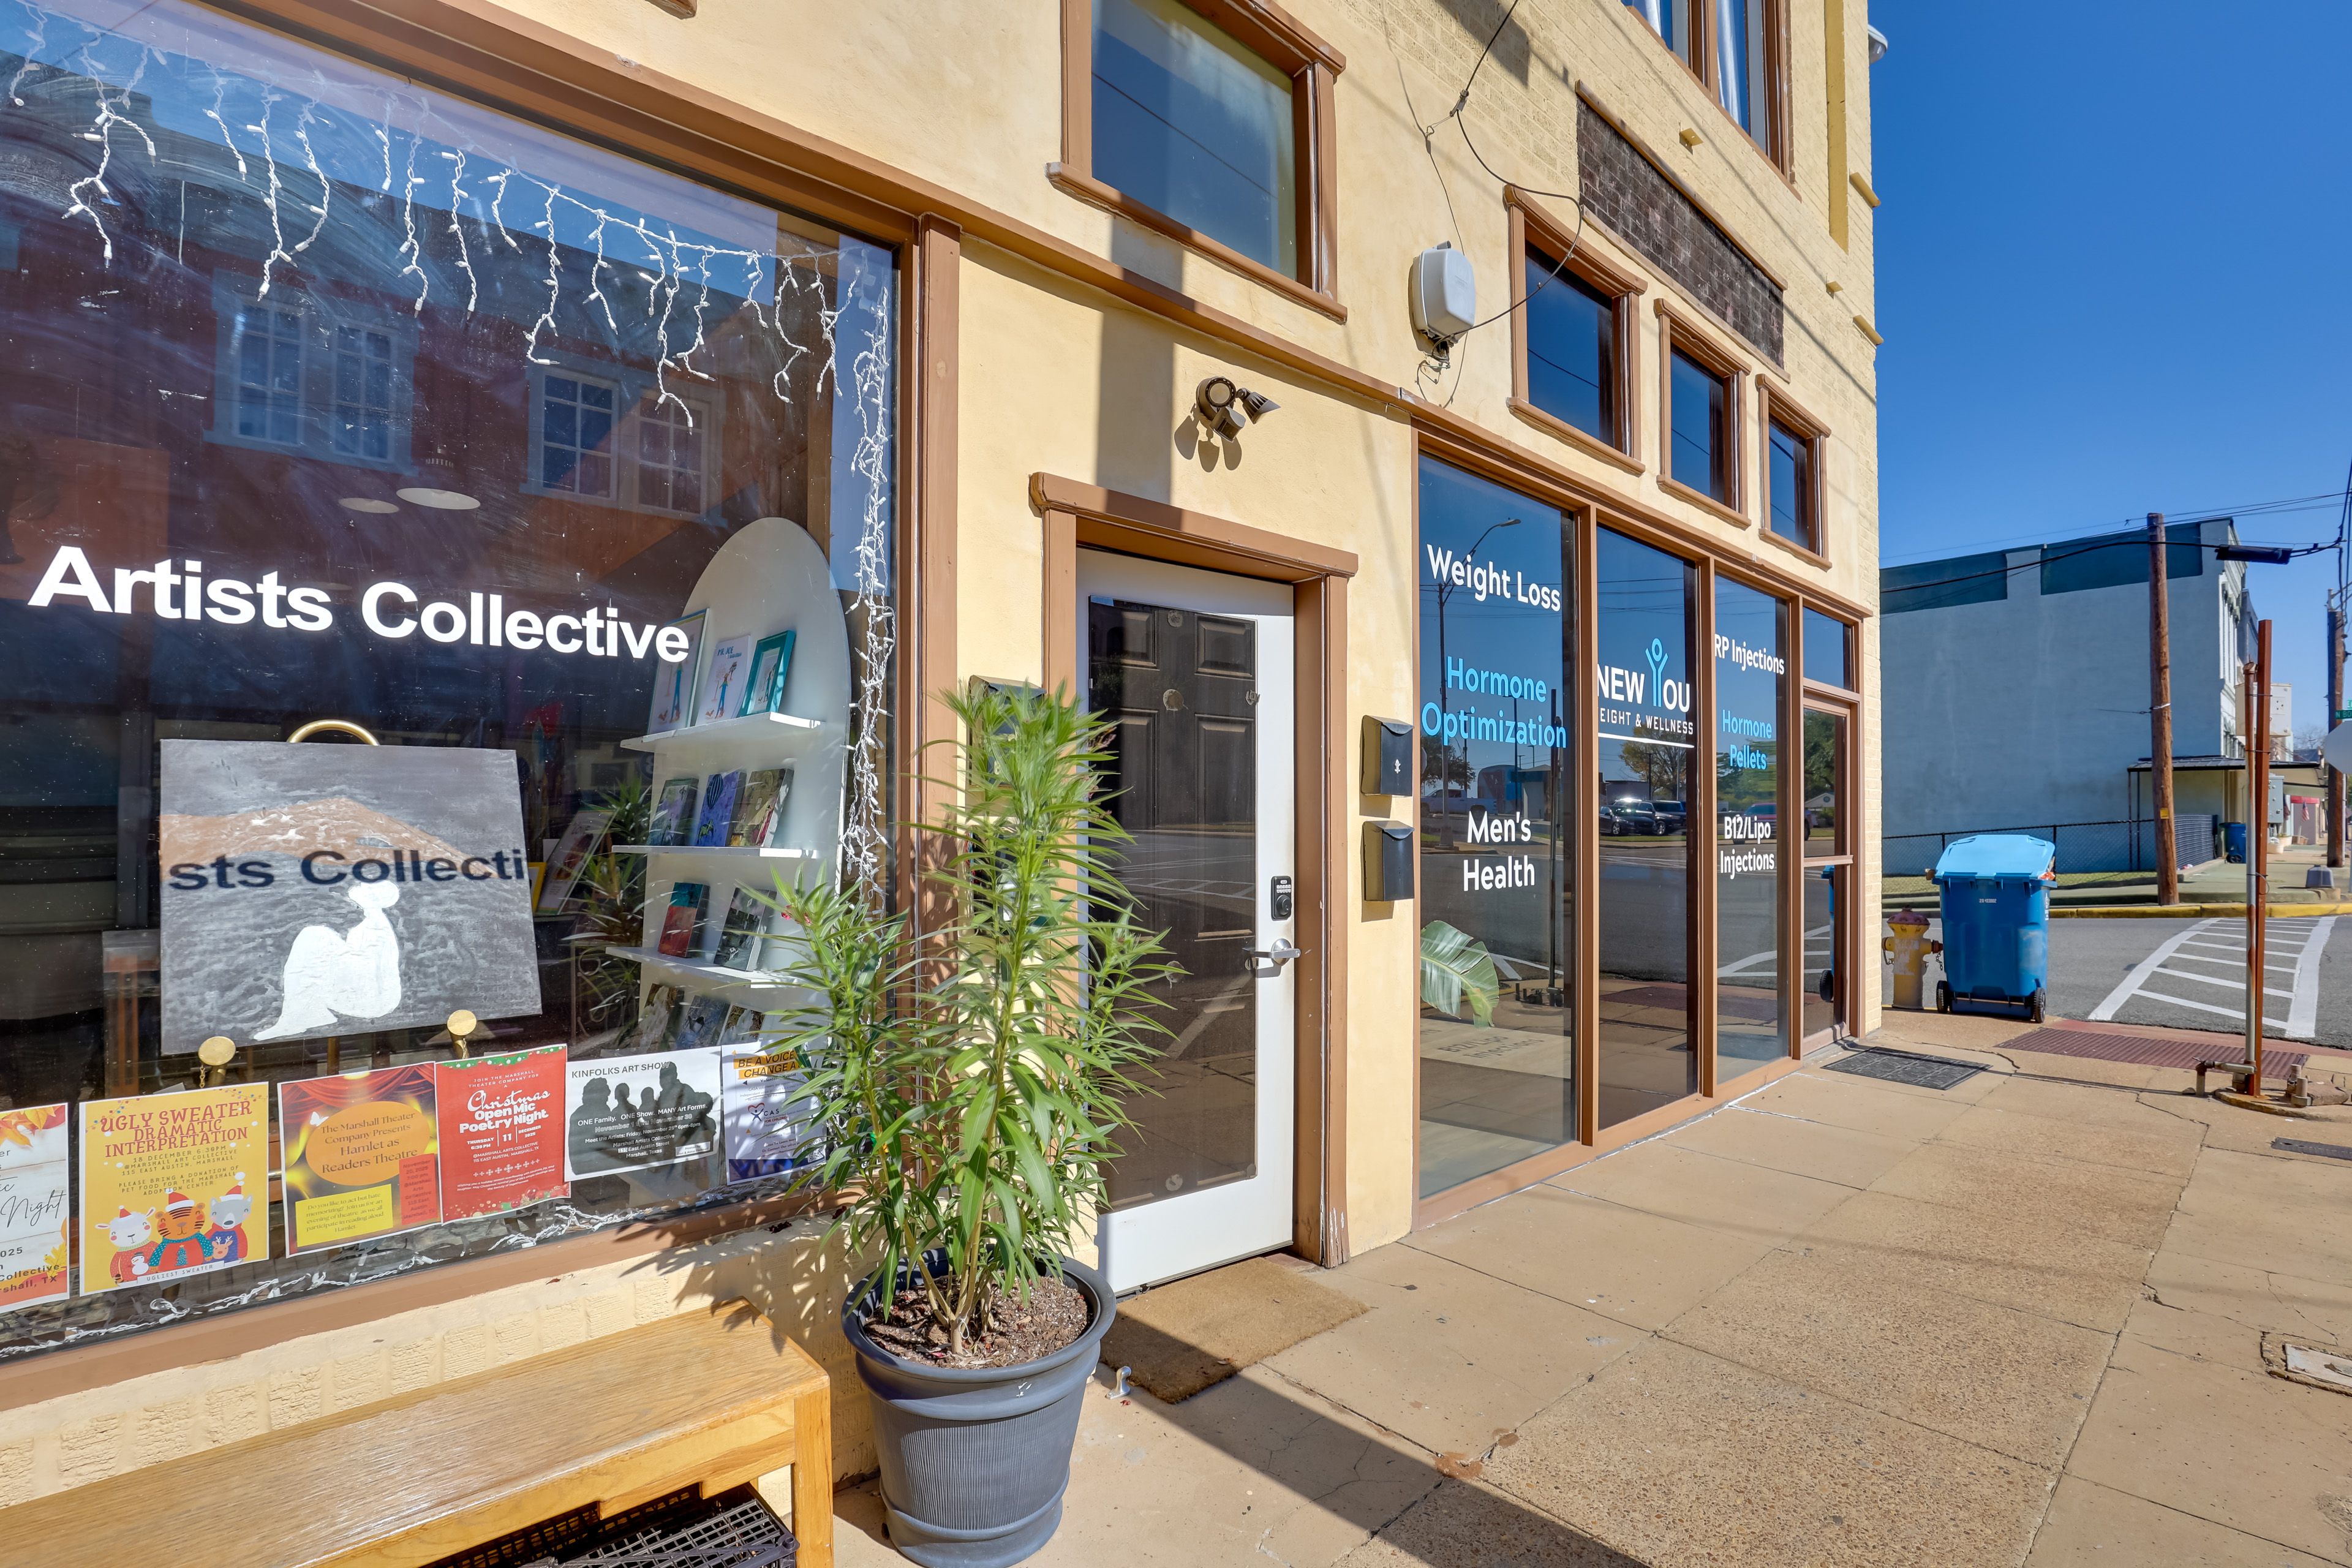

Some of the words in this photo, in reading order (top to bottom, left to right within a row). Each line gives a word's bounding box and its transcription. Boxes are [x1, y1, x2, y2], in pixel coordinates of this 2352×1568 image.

[1427, 544, 1510, 601] Weight
[1518, 571, 1561, 612] Loss
[28, 546, 333, 632] Artists
[361, 581, 689, 663] Collective
[1732, 639, 1785, 675] Injections
[1447, 656, 1547, 702] Hormone
[1597, 663, 1645, 704] NEW
[1645, 643, 1691, 712] YOU
[1422, 702, 1567, 748] Optimization
[1599, 707, 1631, 726] EIGHT
[1635, 714, 1642, 728] &
[1646, 715, 1694, 735] WELLNESS
[1722, 709, 1773, 739] Hormone
[1730, 744, 1767, 770] Pellets
[1467, 810, 1531, 843] Men's
[1724, 815, 1771, 844] B12/Lipo
[1463, 855, 1535, 891] Health
[1720, 848, 1775, 880] Injections
[571, 1066, 620, 1079] KINFOLKS
[622, 1065, 639, 1074] ART
[641, 1061, 671, 1071] SHOW
[738, 1058, 754, 1068] BE
[755, 1057, 762, 1065] A
[766, 1050, 794, 1063] VOICE
[505, 1070, 535, 1079] MARSHALL
[744, 1063, 788, 1078] CHANGE
[467, 1090, 551, 1112] Christmas
[475, 1107, 512, 1121] Open
[513, 1102, 536, 1115] Mic
[100, 1112, 154, 1133] UGLY
[159, 1101, 253, 1125] SWEATER
[341, 1117, 380, 1131] Marshall
[381, 1112, 416, 1124] Theater
[459, 1117, 513, 1134] Poetry
[514, 1109, 549, 1125] Night
[594, 1115, 617, 1125] Family.
[594, 1123, 630, 1133] November
[134, 1119, 222, 1142] DRAMATIC
[325, 1129, 372, 1145] Company
[373, 1123, 411, 1137] Presents
[502, 1133, 512, 1142] 11
[518, 1125, 541, 1134] DECEMBER
[105, 1126, 249, 1158] INTERPRETATION
[341, 1141, 385, 1156] Hamlet
[386, 1139, 400, 1147] as
[473, 1150, 502, 1158] @MARSHALL
[514, 1142, 538, 1150] COLLECTIVE
[124, 1159, 171, 1170] @MARSHALL
[192, 1149, 238, 1161] COLLECTIVE
[148, 1150, 192, 1161] DECEMBER
[322, 1158, 371, 1174] Readers
[372, 1149, 418, 1165] Theatre
[119, 1180, 146, 1188] PLEASE
[150, 1175, 176, 1183] BRING
[188, 1167, 227, 1178] DONATION
[199, 1171, 236, 1182] MARSHALL
[143, 1185, 183, 1196] ADOPTION
[0, 1189, 66, 1227] Night
[146, 1271, 178, 1282] UGLIEST
[182, 1264, 214, 1275] SWEATER
[0, 1280, 37, 1294] shall,
[42, 1275, 57, 1284] TX
